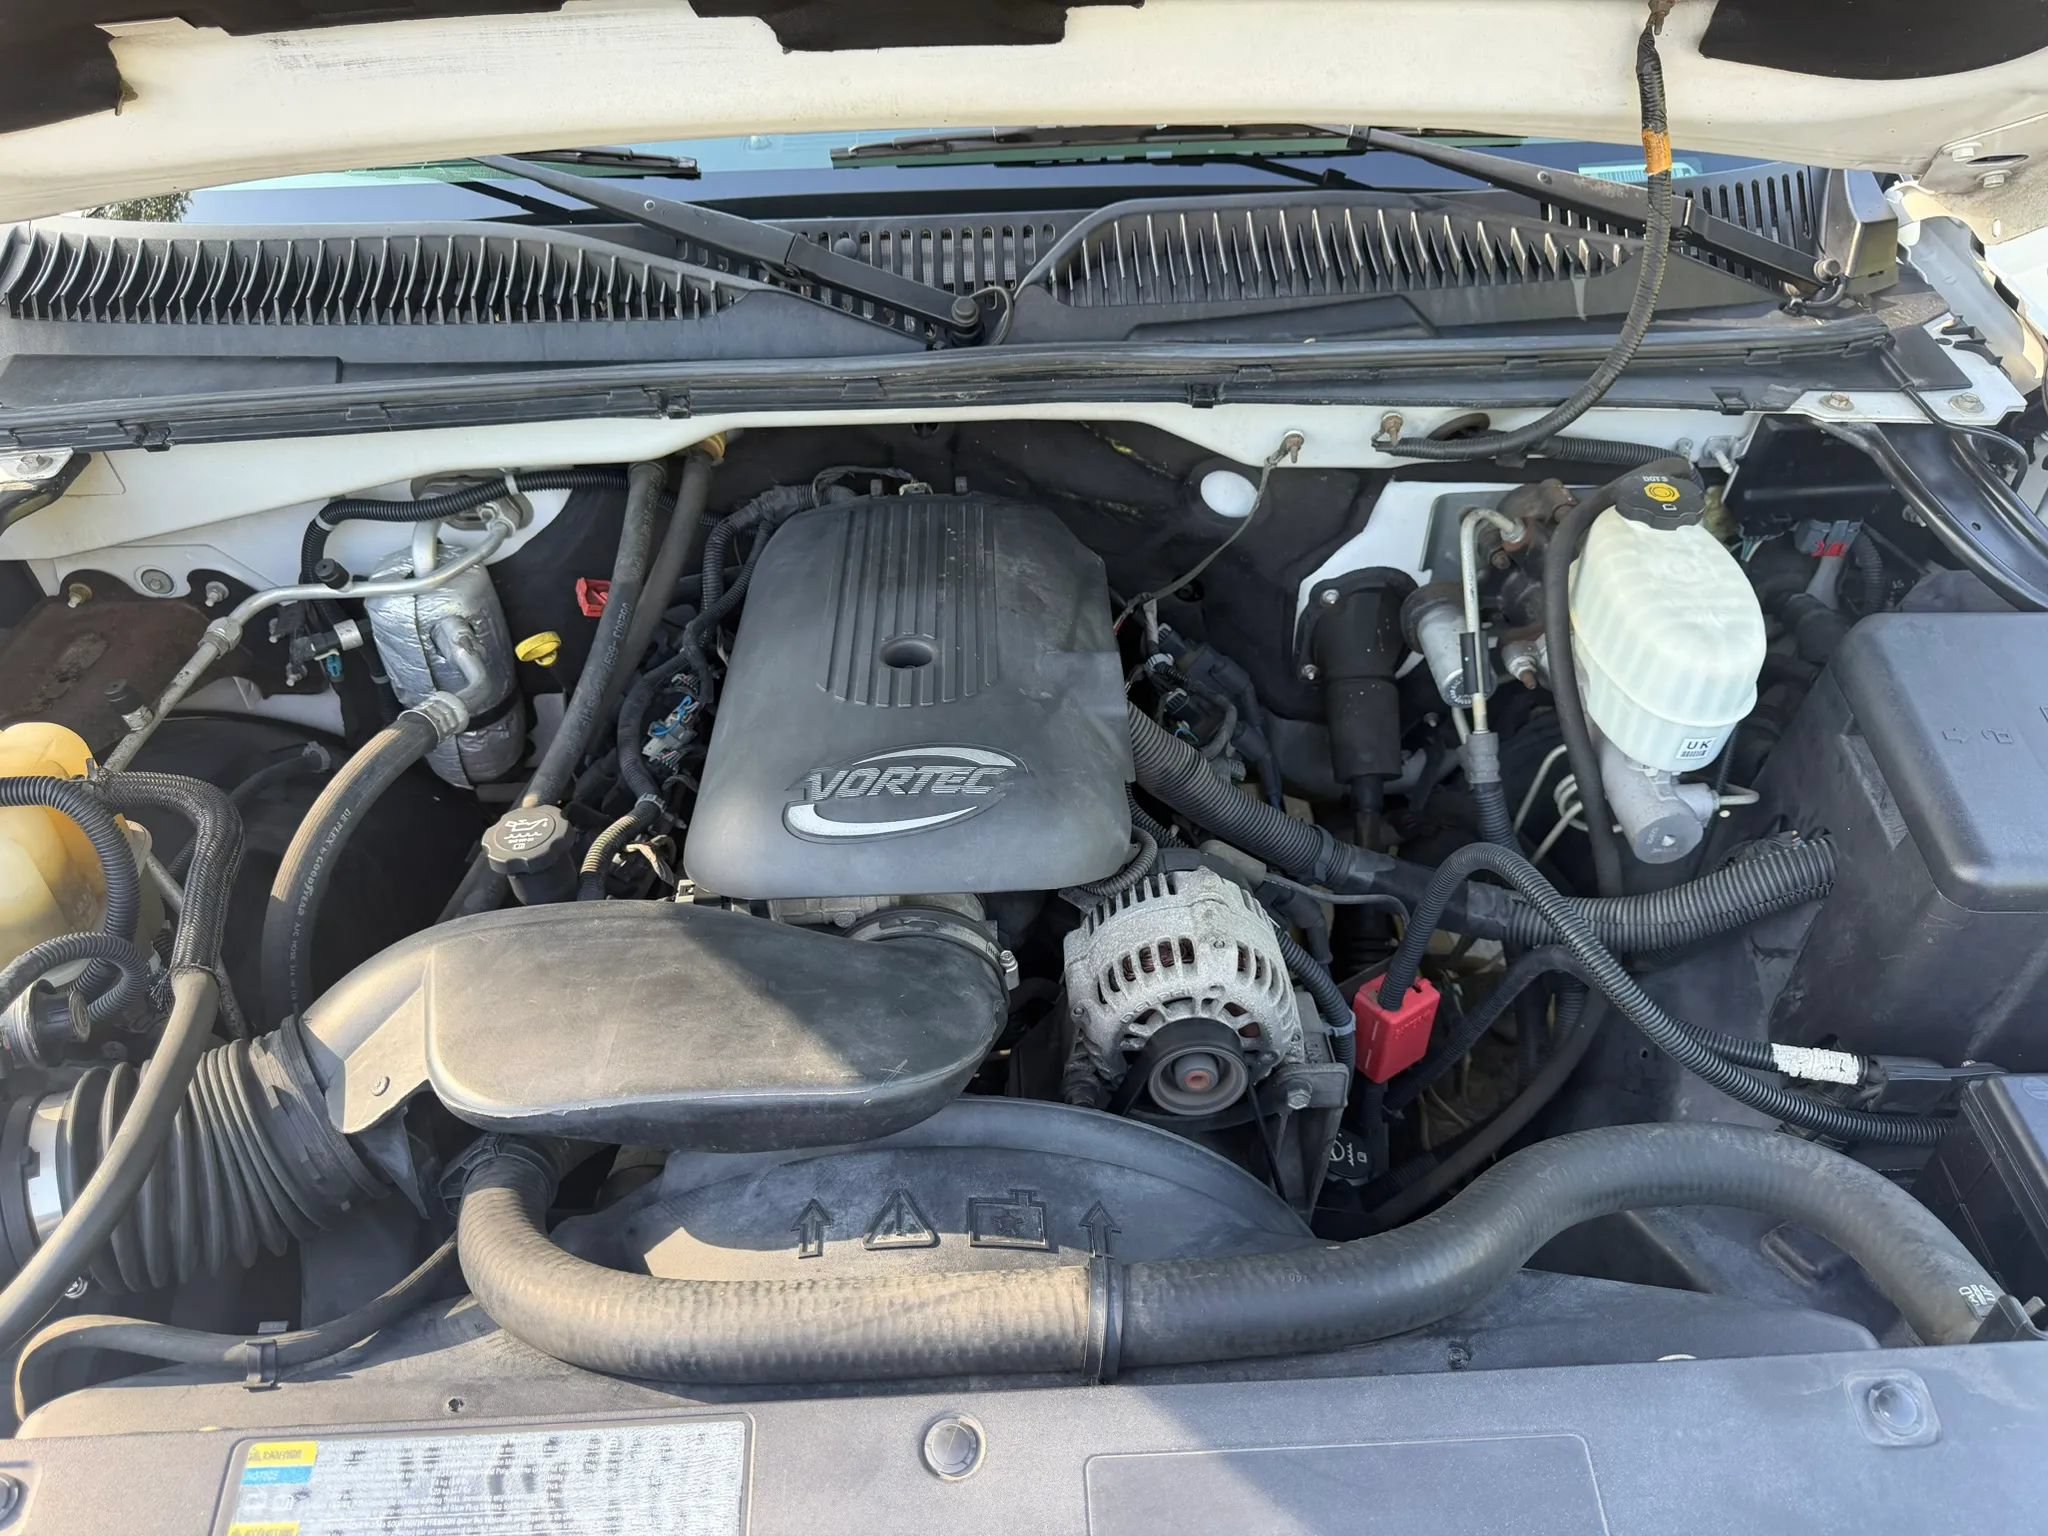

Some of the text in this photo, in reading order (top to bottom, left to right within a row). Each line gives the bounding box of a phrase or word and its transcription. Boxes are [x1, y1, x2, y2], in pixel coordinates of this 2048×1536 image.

[1687, 740, 1712, 750] UK
[806, 765, 1008, 801] VORTEC
[297, 855, 325, 917] GOODYEAR
[1980, 1285, 1995, 1302] UP
